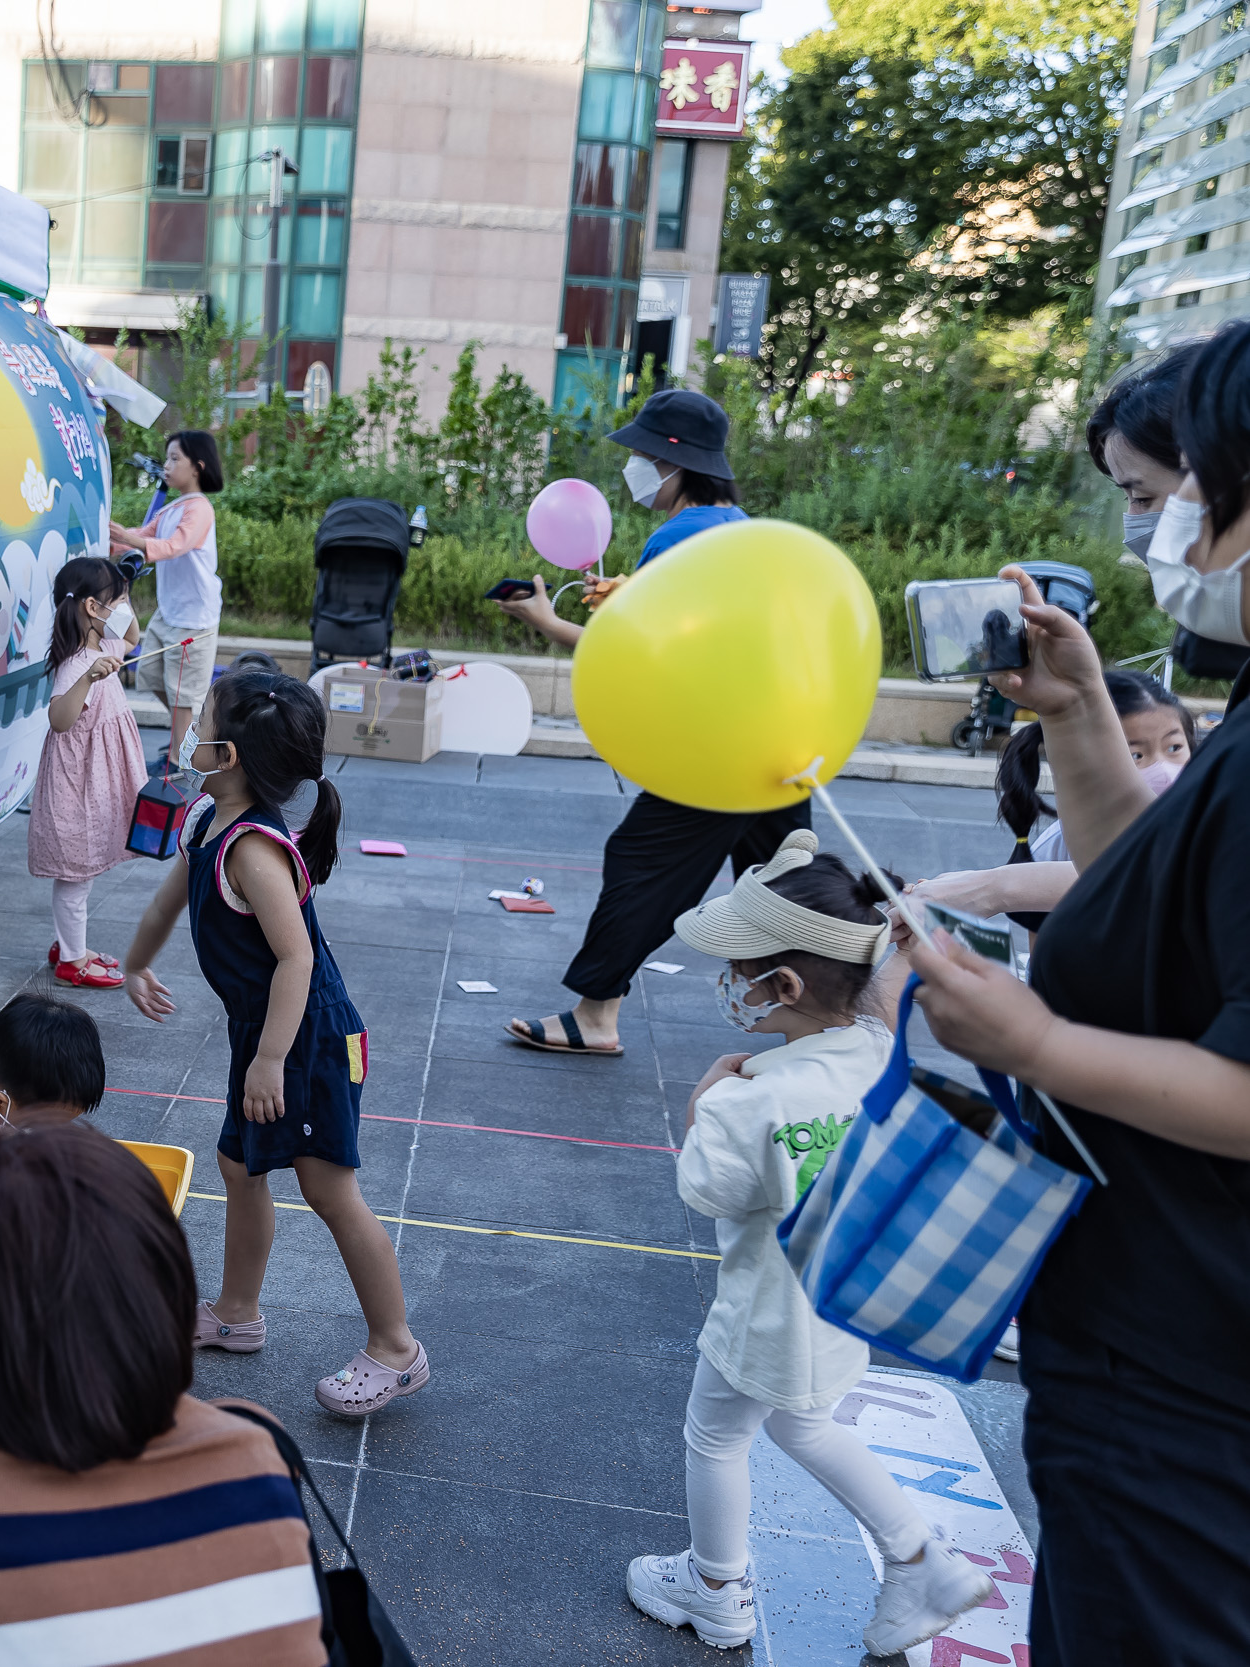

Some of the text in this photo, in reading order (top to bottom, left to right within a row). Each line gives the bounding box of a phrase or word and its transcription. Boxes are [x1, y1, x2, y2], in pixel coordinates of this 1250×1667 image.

[49, 402, 97, 480] 한가위
[773, 1113, 840, 1160] TOM
[661, 1575, 676, 1583] FILA
[739, 1596, 754, 1610] FIL
